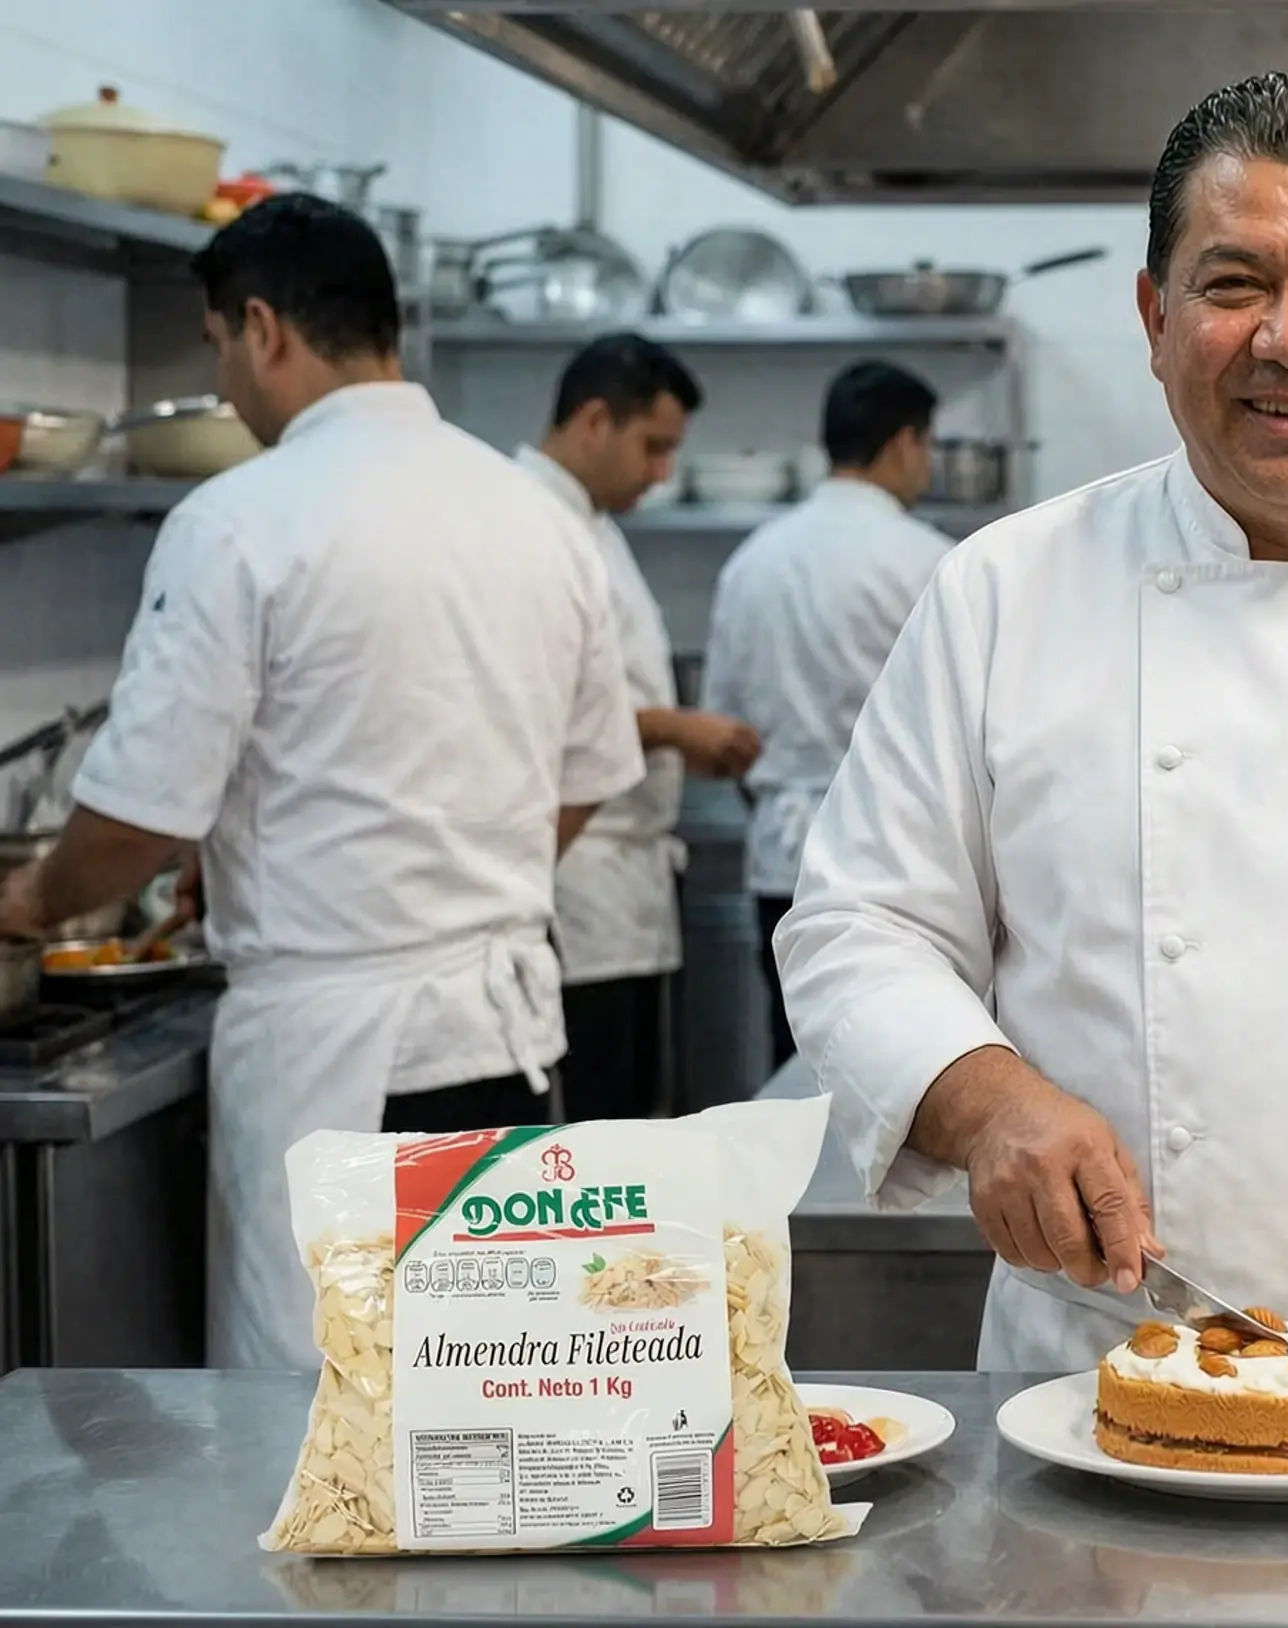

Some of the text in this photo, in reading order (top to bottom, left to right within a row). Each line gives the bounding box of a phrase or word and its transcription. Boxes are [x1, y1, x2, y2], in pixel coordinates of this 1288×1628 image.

[462, 1185, 648, 1236] DON EFE
[413, 1331, 559, 1368] Almendra
[566, 1325, 704, 1365] Fileteada
[482, 1376, 633, 1399] Cont. Neto 1 Kg
